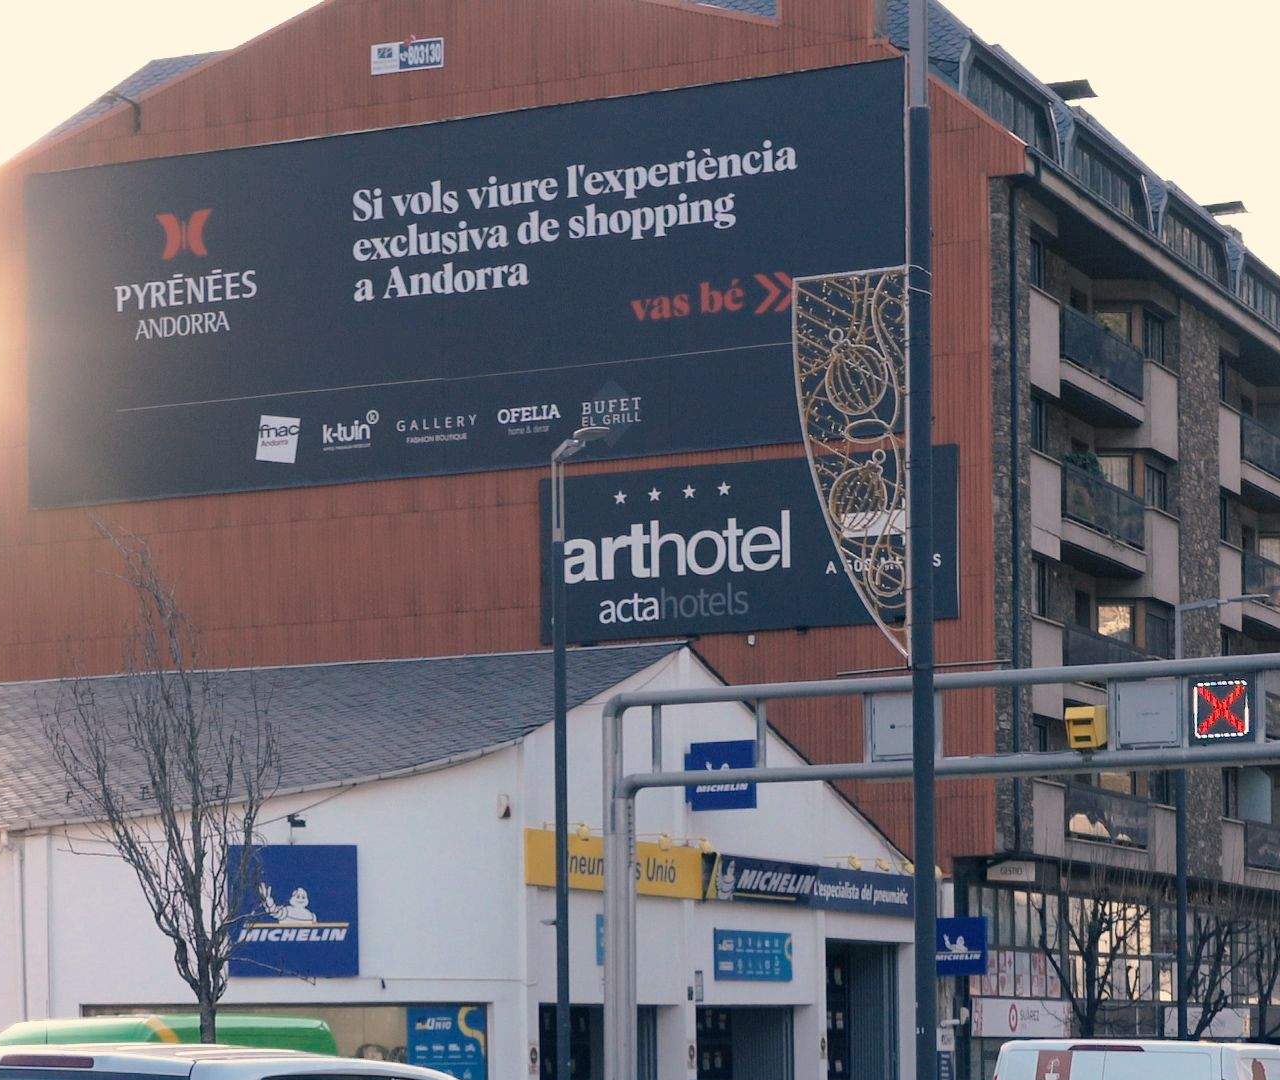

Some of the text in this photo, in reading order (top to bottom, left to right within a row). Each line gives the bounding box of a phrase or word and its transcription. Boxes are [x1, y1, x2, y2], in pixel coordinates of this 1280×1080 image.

[352, 138, 798, 222] Si vols viure l'experiència
[352, 191, 736, 262] exclusiva de shopping
[353, 259, 530, 302] a Andorra
[631, 277, 746, 322] vas bé
[134, 310, 231, 341] ANDORRA
[497, 404, 562, 425] OFELIA
[582, 397, 641, 415] BUFET
[396, 414, 477, 432] GALLERY
[582, 411, 641, 427] EL GRILL
[259, 423, 301, 439] fnac
[406, 432, 468, 444] FASHION BOUTIQUE
[564, 510, 792, 584] arthotel
[825, 560, 838, 575] A
[695, 782, 749, 793] MICHELIN
[646, 857, 677, 884] Unió
[737, 868, 816, 895] MICHELIN
[814, 878, 860, 901] L'especialista
[861, 883, 873, 901] del
[237, 928, 348, 942] MICHELIN
[935, 952, 982, 961] MICHELIN
